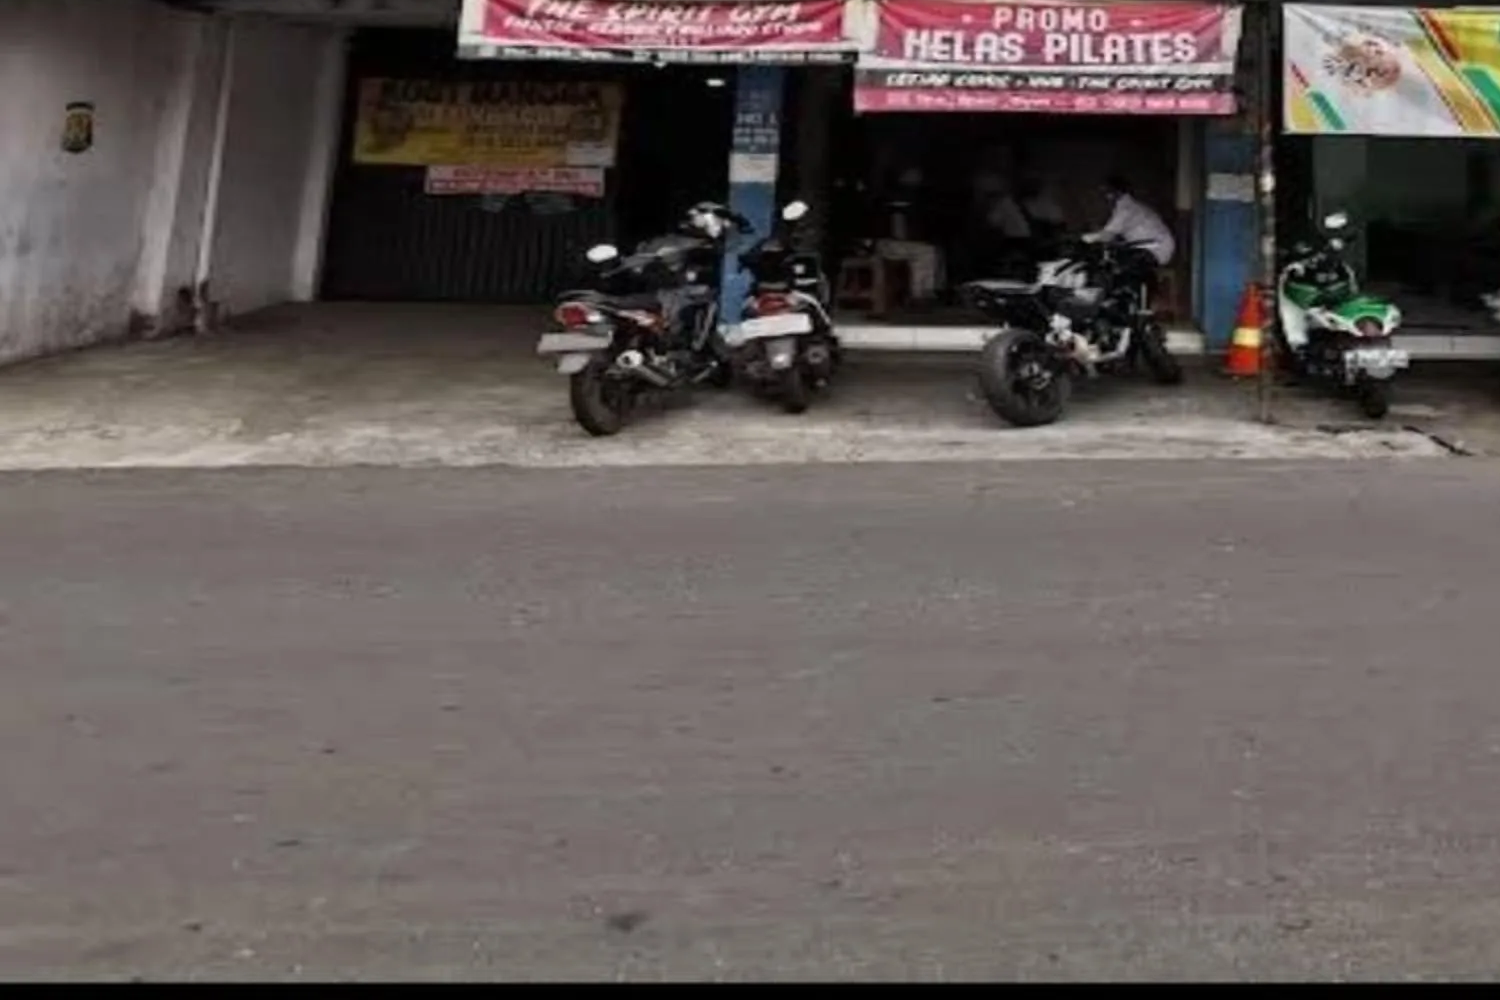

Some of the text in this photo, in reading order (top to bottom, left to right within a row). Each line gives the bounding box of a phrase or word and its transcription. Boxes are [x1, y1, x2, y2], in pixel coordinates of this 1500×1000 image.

[729, 0, 801, 22] GYM
[994, 7, 1109, 31] PROMO
[1043, 33, 1197, 64] PILATES
